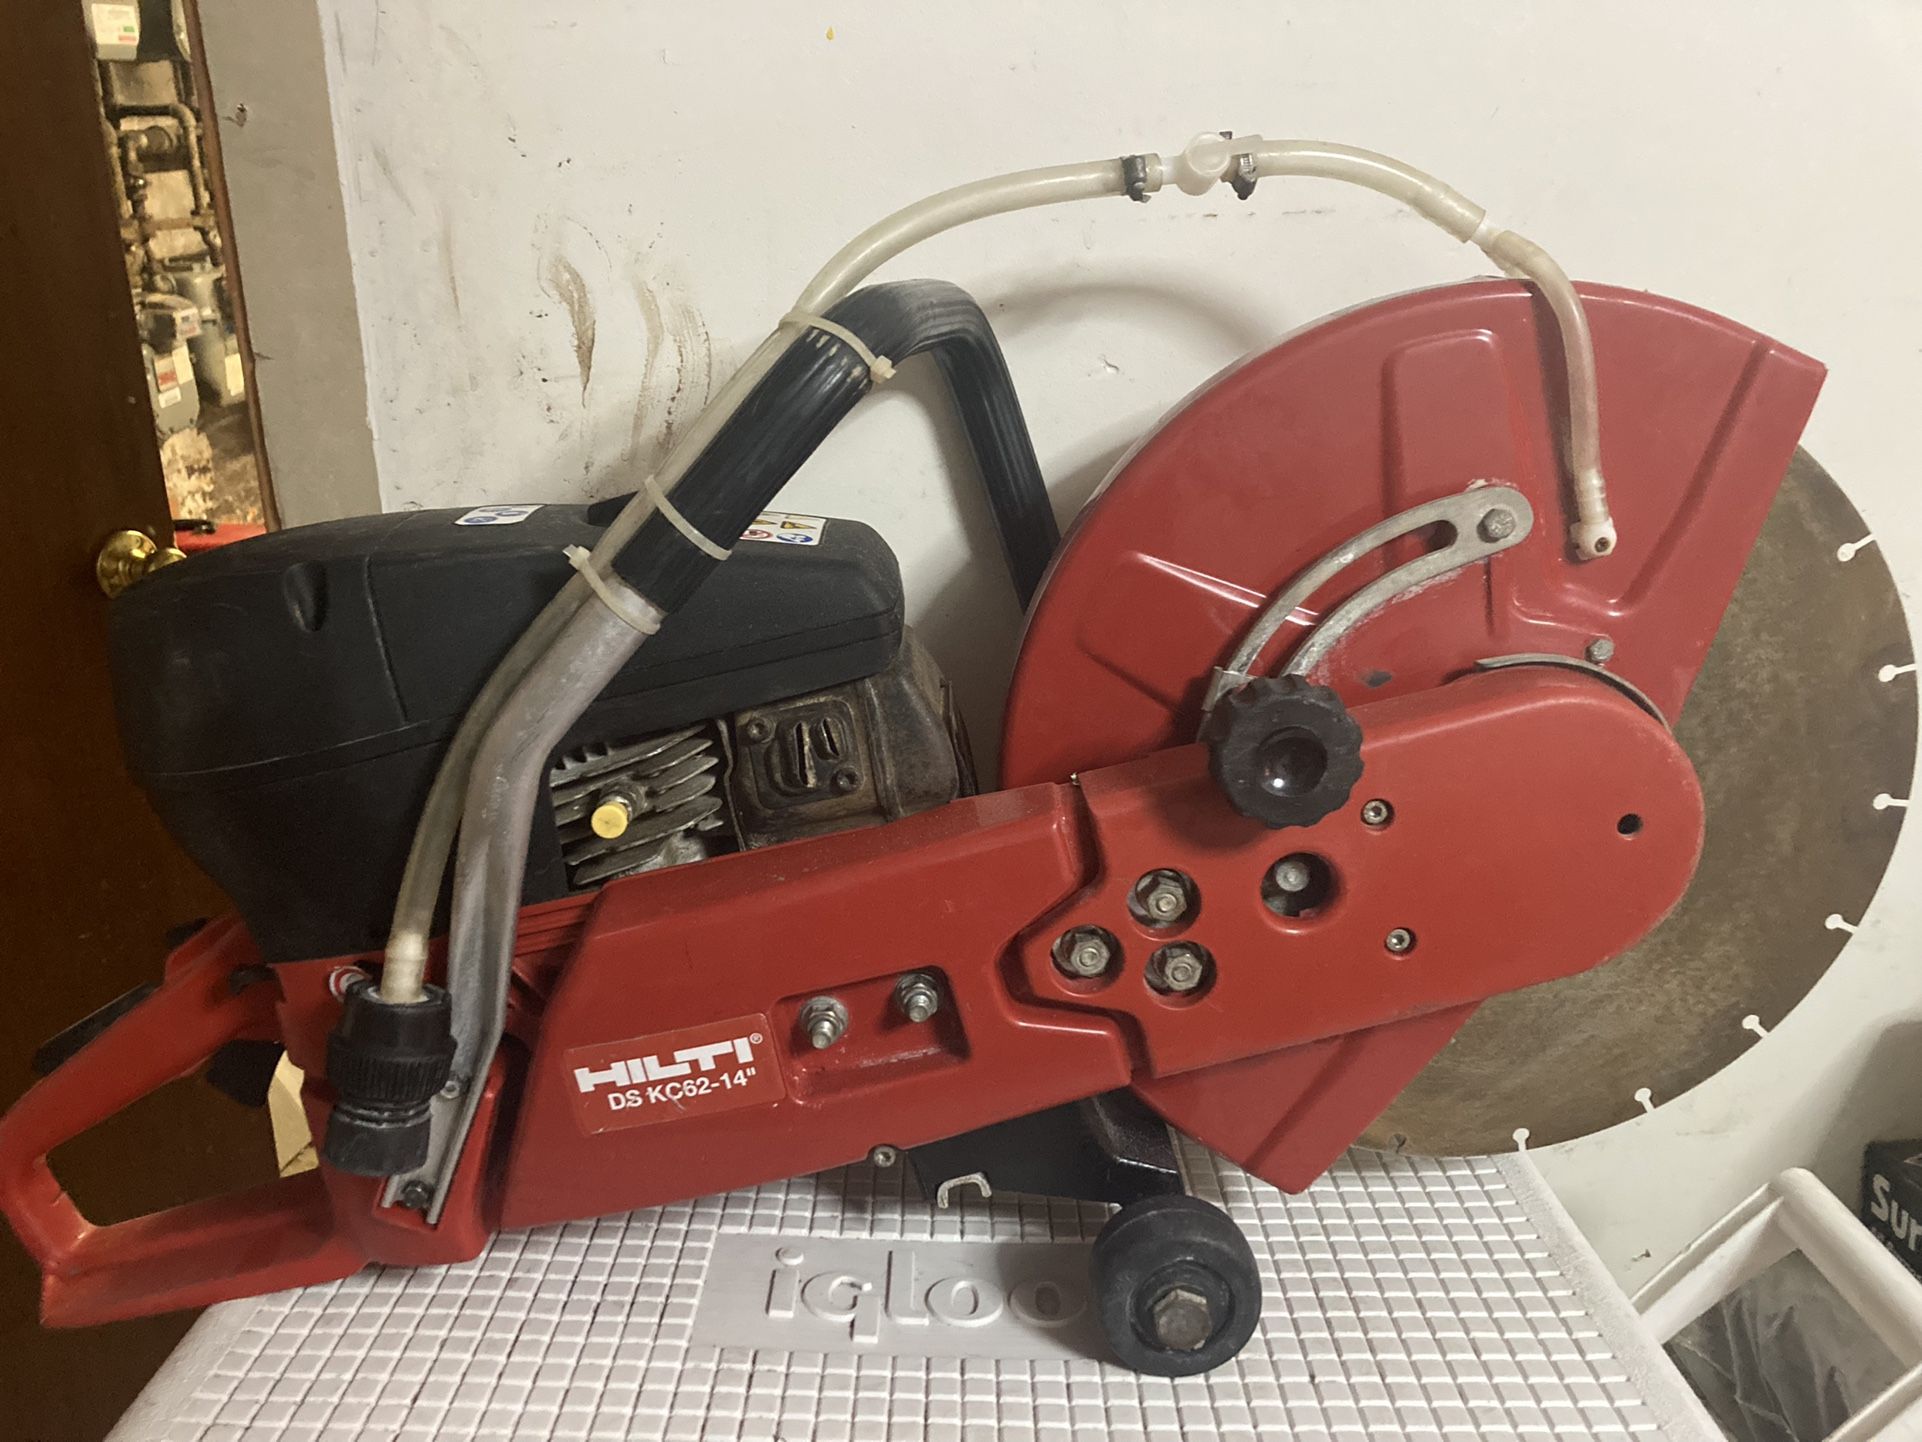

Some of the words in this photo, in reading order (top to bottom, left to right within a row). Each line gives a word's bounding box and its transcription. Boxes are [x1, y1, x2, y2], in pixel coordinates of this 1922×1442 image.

[607, 1091, 643, 1111] DS
[648, 1067, 757, 1105] KC62-14"
[766, 1246, 1087, 1343] igloo
